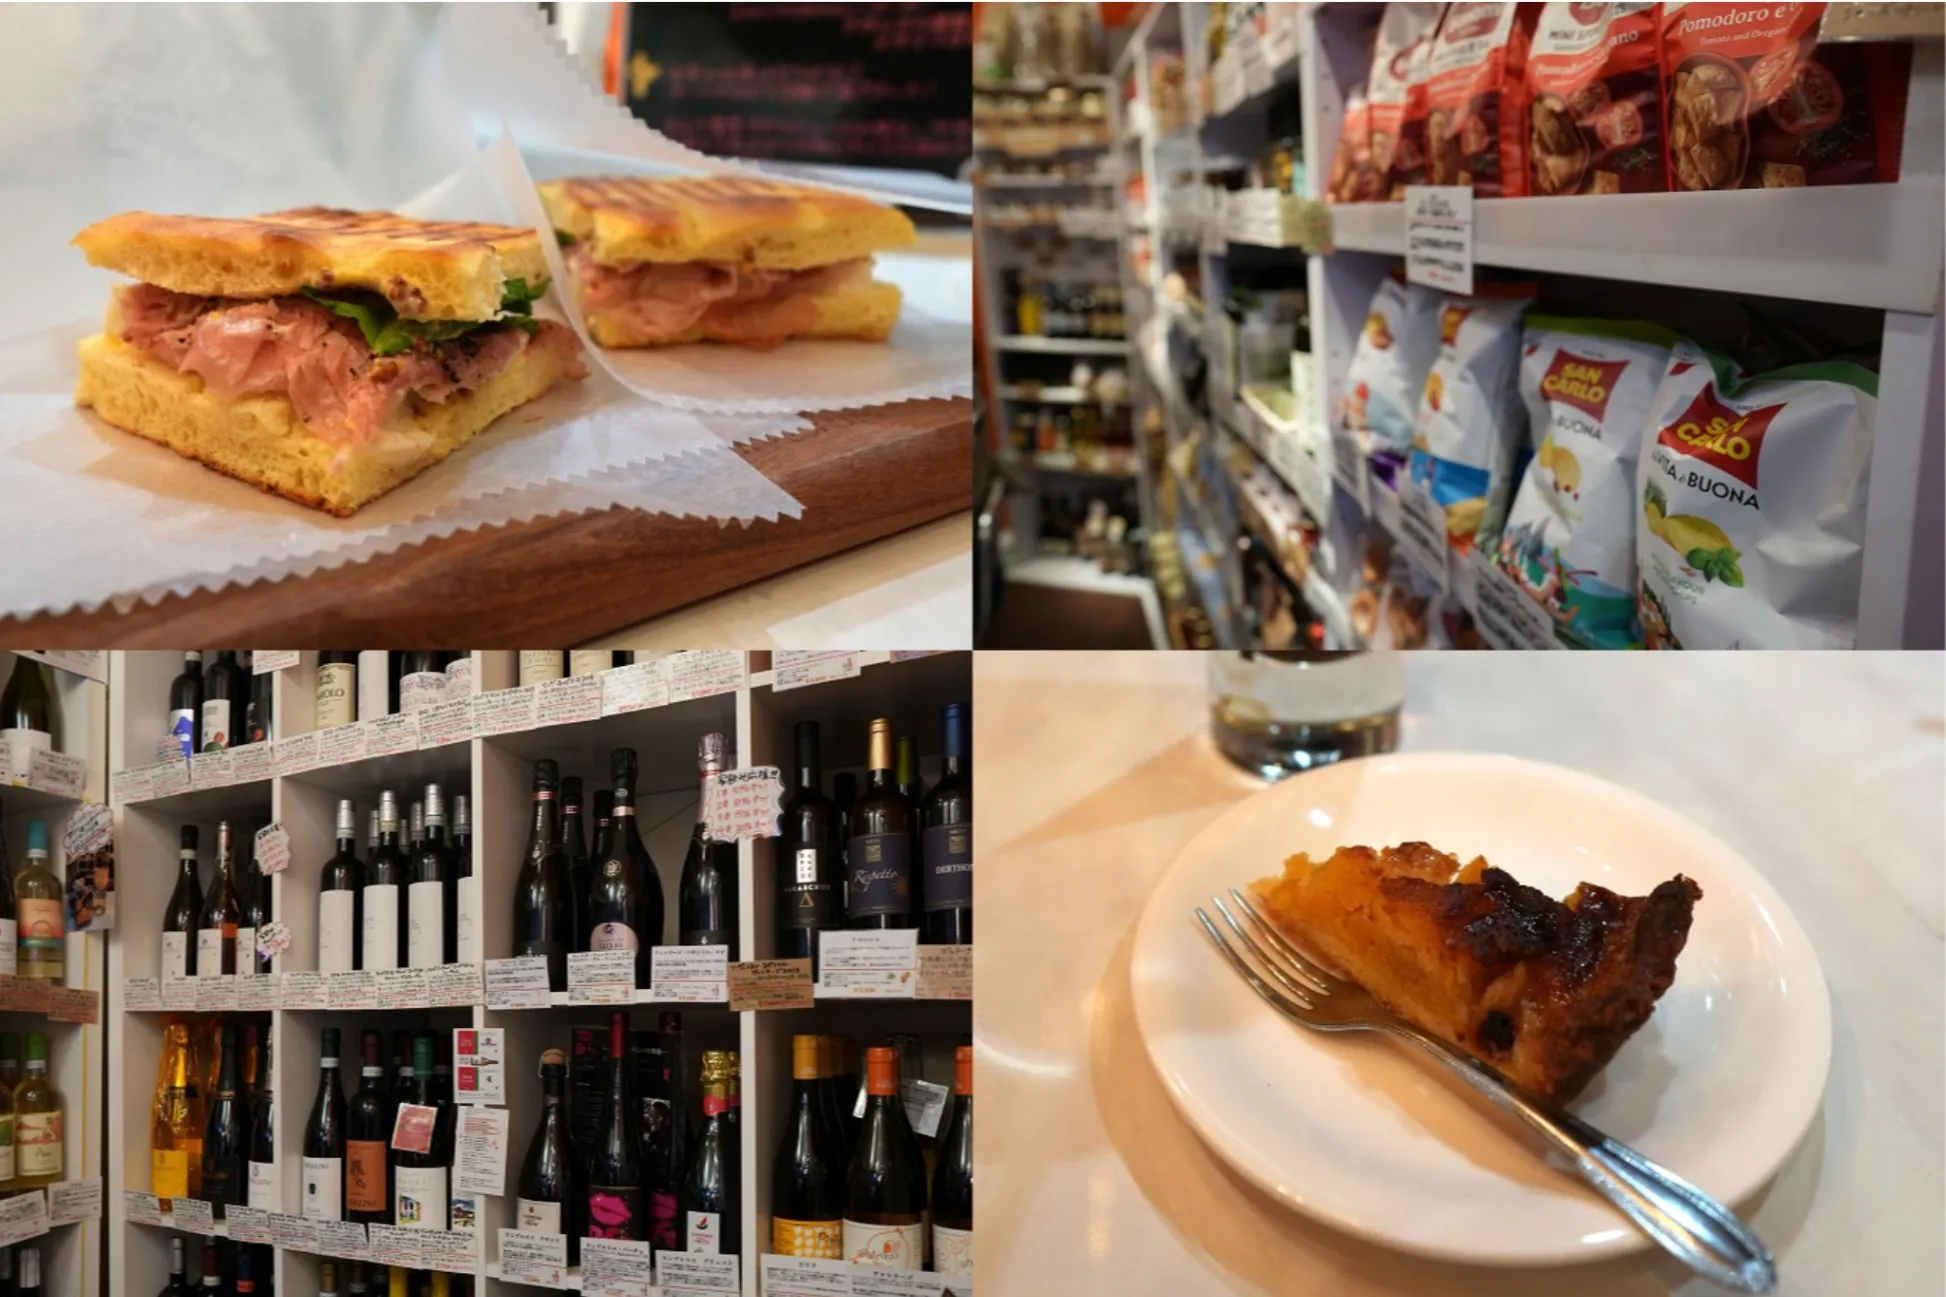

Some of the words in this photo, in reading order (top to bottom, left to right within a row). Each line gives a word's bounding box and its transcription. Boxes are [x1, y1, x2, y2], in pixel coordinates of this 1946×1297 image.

[1678, 8, 1769, 36] Pomodoro
[1772, 6, 1785, 19] e
[1562, 362, 1602, 384] SAN
[1543, 375, 1606, 403] CARLO
[1687, 471, 1760, 510] BUONA
